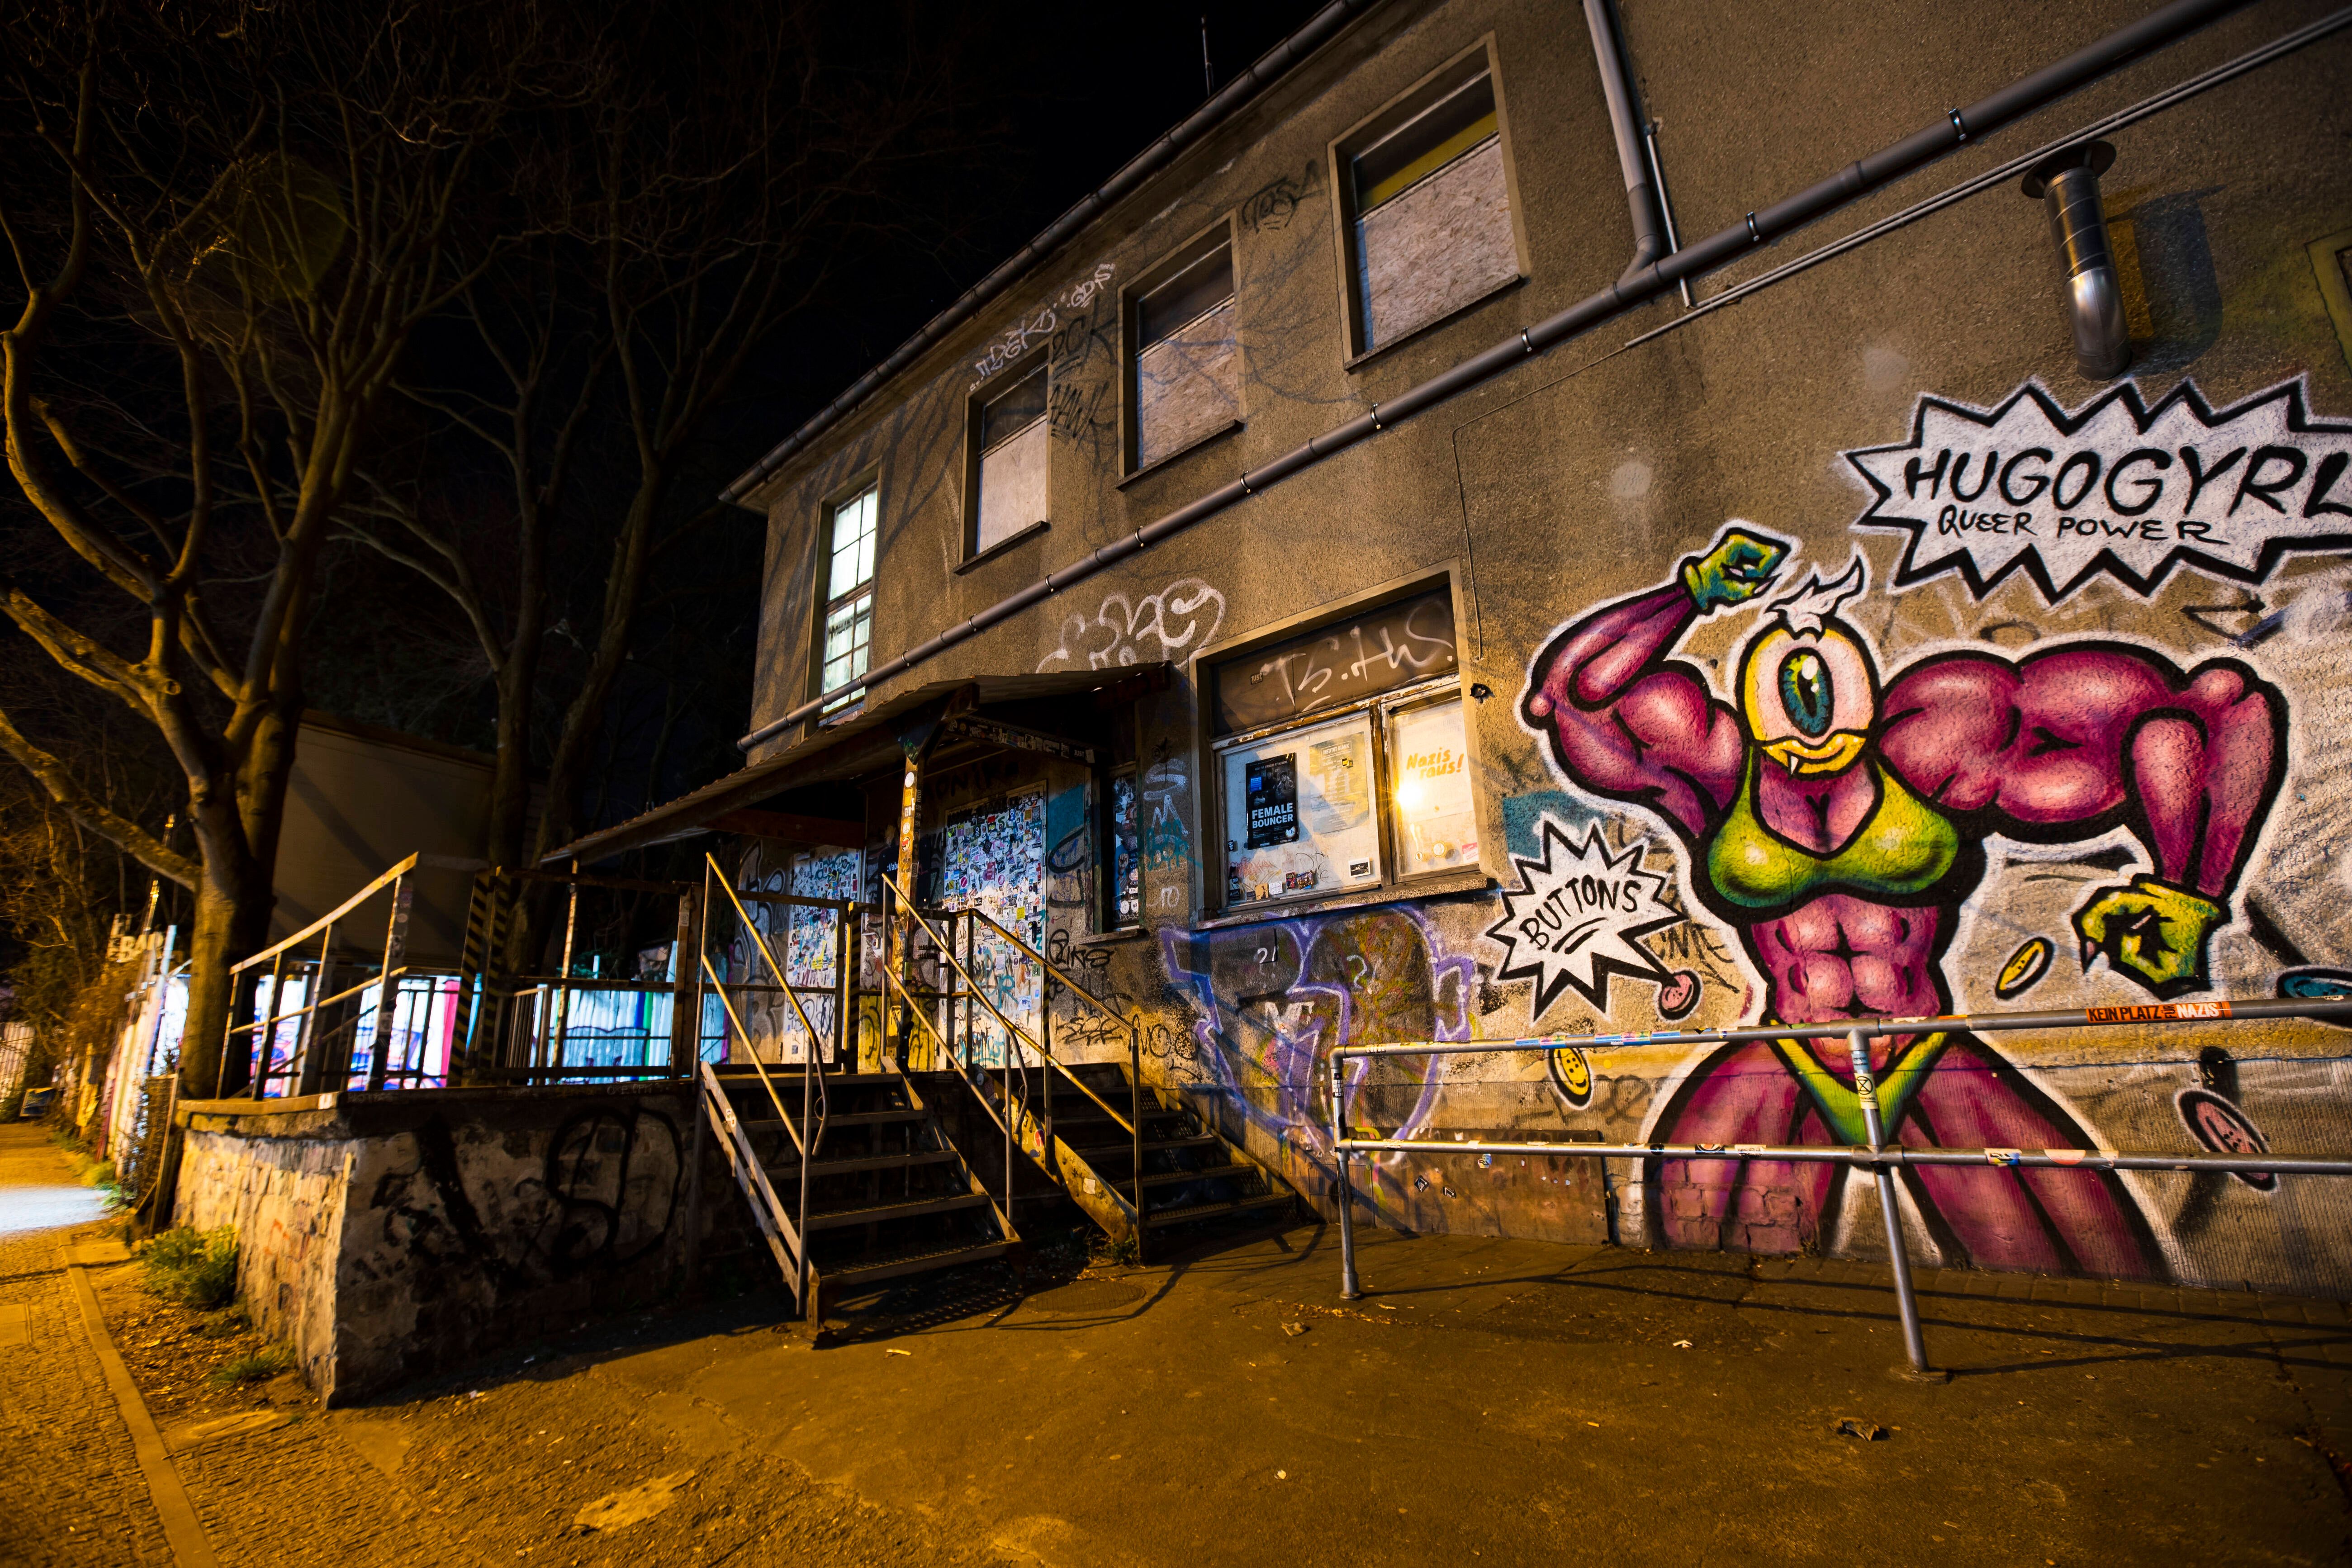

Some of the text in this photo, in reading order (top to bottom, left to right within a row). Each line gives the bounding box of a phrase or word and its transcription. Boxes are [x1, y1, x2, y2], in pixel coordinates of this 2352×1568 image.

[1903, 444, 2352, 519] HUGOGYRL
[1938, 504, 2230, 546] QUEER POWER
[1406, 747, 1451, 770] Nazis
[1418, 753, 1465, 780] raus!
[1252, 802, 1293, 820] FEMALE
[1252, 814, 1294, 829] BOUNCER
[1519, 874, 1641, 951] BUTTONS
[2088, 1002, 2220, 1022] KEIN PLATZ FÜR NAZIS
